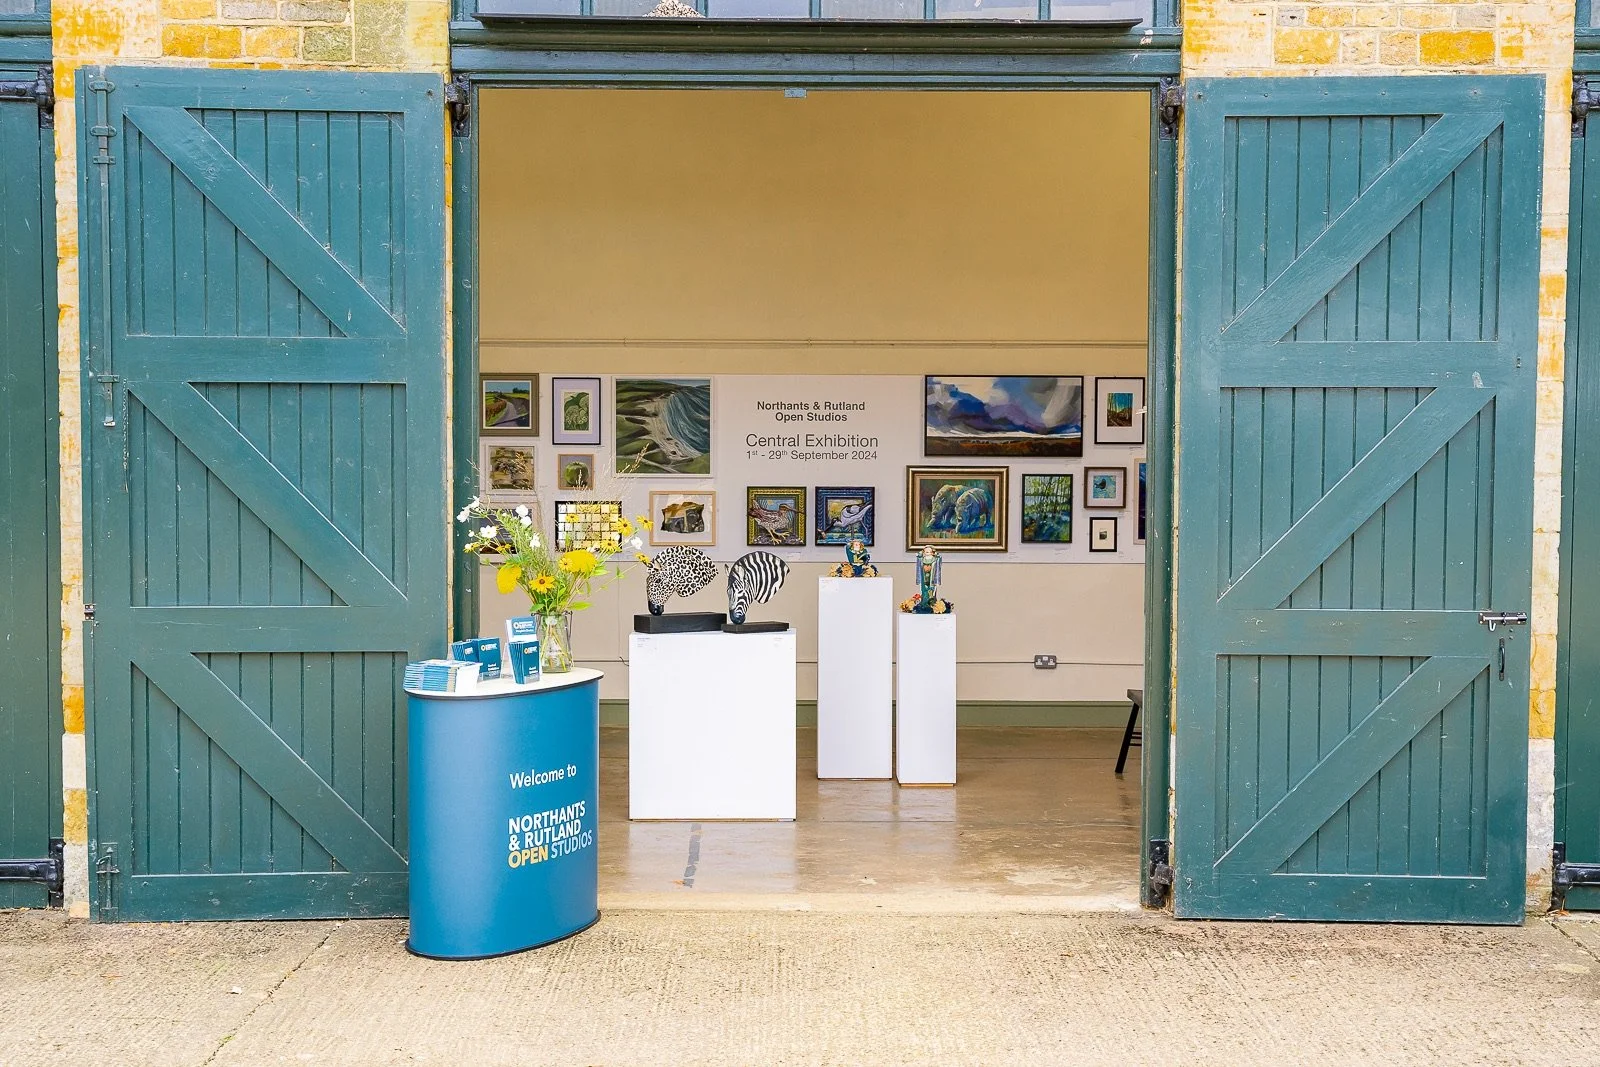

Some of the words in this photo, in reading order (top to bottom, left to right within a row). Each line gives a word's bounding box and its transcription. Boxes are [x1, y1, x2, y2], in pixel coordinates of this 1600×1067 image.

[757, 401, 810, 410] Northants
[813, 402, 820, 410] &
[824, 402, 866, 410] Rutland
[775, 412, 804, 423] Open
[807, 412, 848, 422] Studios
[746, 434, 800, 447] Central
[806, 434, 878, 447] Exhibition
[746, 450, 758, 460] 1st
[768, 450, 788, 460] 29th
[790, 450, 848, 461] September
[852, 450, 878, 460] 2024
[510, 769, 564, 789] Welcome
[567, 764, 576, 778] to
[508, 800, 586, 834] NORTHANTS
[508, 834, 520, 851] &
[524, 819, 580, 849] RUTLAND
[508, 844, 548, 868] OPEN
[551, 830, 592, 858] STUDIOS
